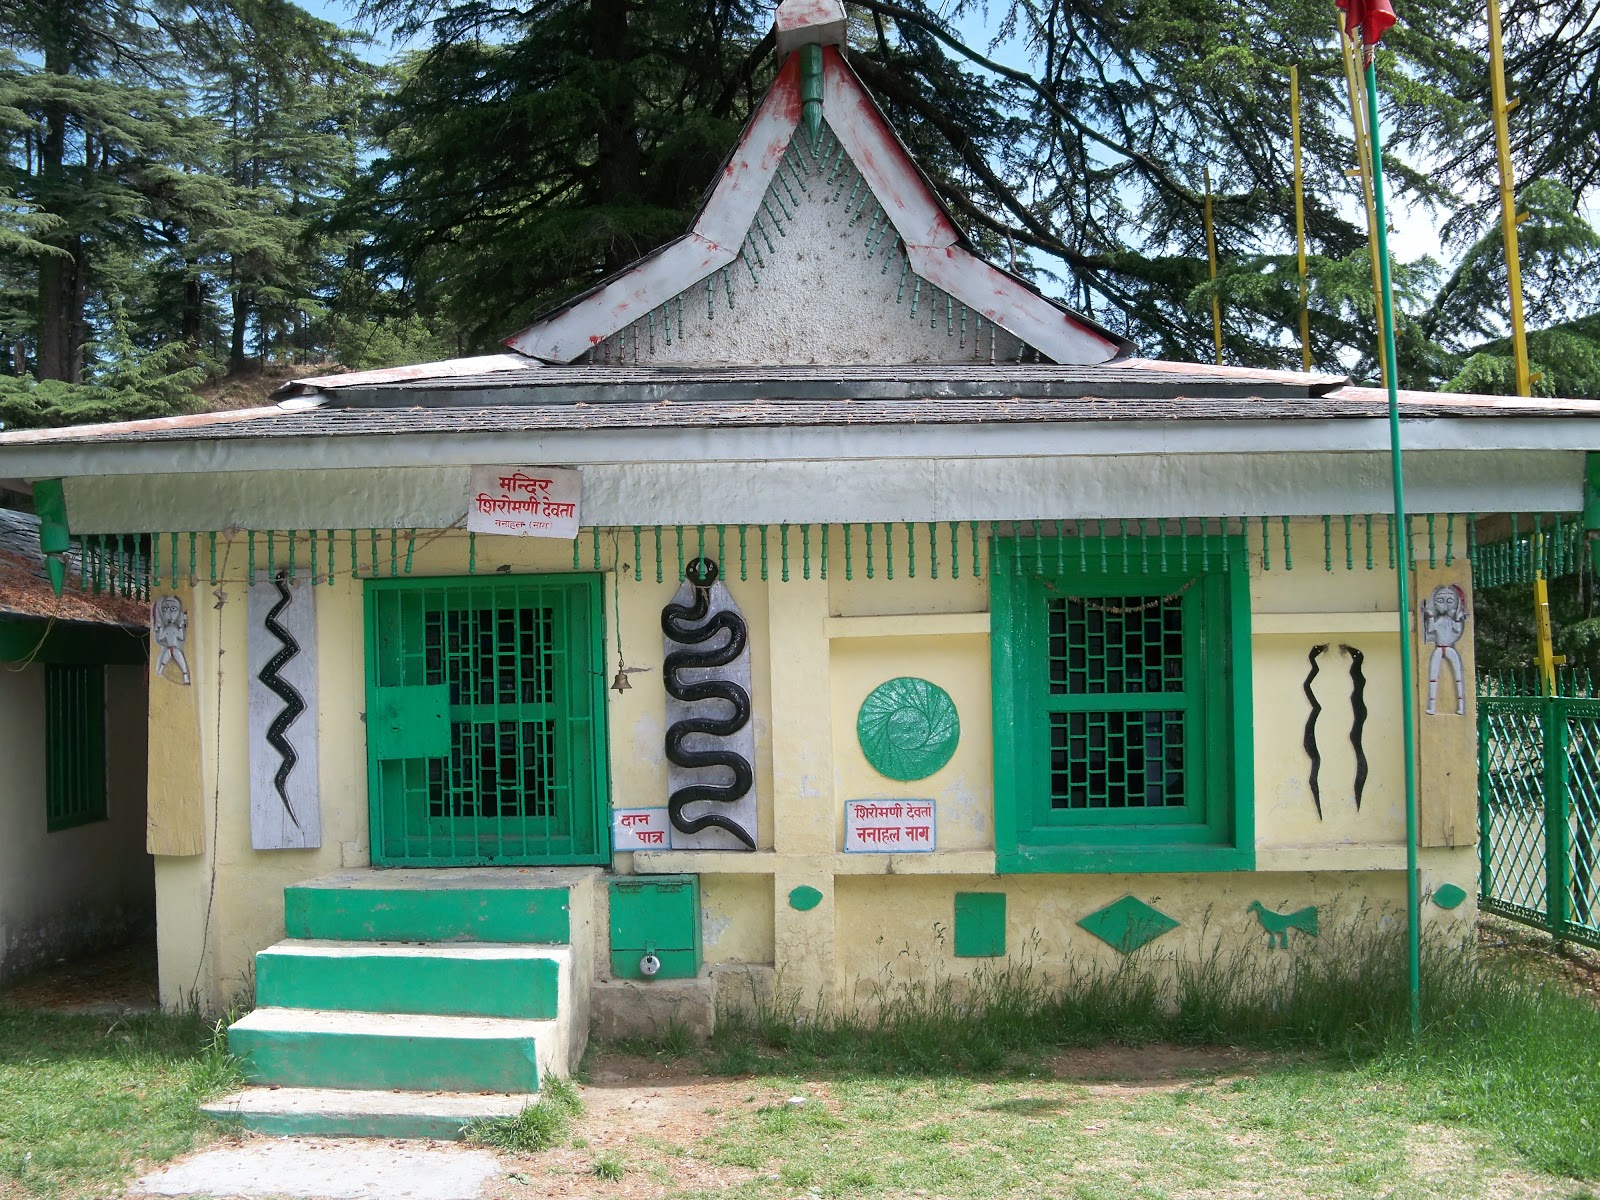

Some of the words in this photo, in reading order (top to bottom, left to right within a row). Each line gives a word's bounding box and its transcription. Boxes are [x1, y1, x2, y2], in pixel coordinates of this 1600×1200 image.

[498, 472, 554, 496] मन्दिर
[475, 492, 541, 516] शिरोमणी
[542, 496, 576, 518] देवता
[854, 803, 904, 820] शिरोमणी
[620, 814, 651, 828] दान
[635, 831, 665, 844] पात्र
[855, 826, 902, 844] ननाहल
[905, 826, 931, 842] नाग
